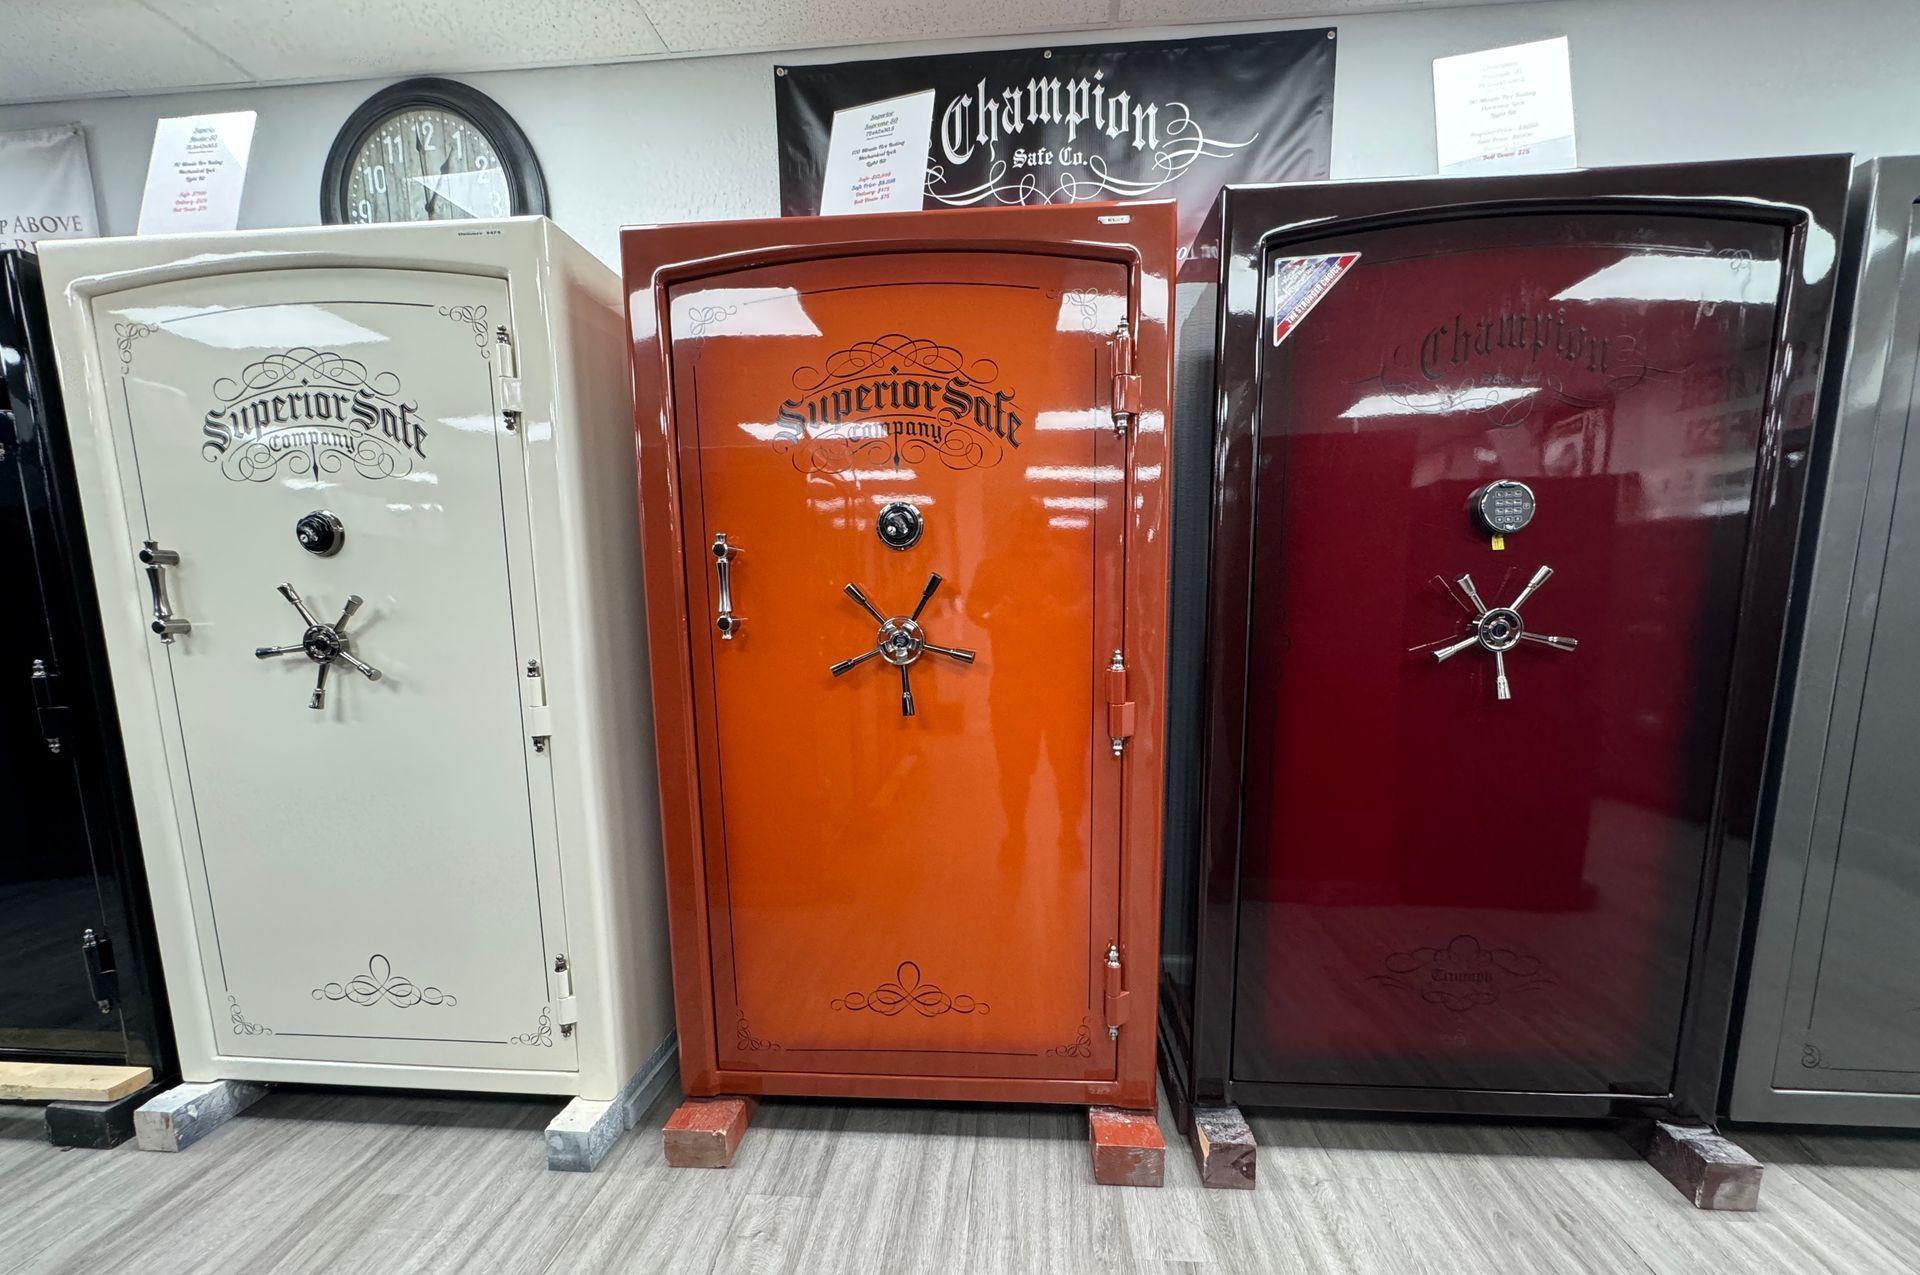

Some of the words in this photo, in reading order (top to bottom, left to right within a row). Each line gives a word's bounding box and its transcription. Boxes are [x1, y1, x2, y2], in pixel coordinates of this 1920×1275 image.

[941, 69, 1160, 165] Champion
[383, 135, 404, 164] 11
[452, 130, 463, 160] 1
[1012, 147, 1053, 169] Safe
[1058, 146, 1088, 166] Co.
[363, 165, 387, 195] 10
[475, 155, 490, 185] 2
[358, 199, 372, 224] 9
[488, 190, 503, 218] 3
[14, 215, 83, 233] ABOVE
[1286, 309, 1300, 324] THE
[1296, 284, 1323, 312] STRONGER
[1320, 263, 1342, 287] CHOICE
[1420, 308, 1610, 381] Champion
[202, 379, 350, 462] Superior
[349, 388, 428, 460] Safe
[773, 367, 942, 454] Superior
[938, 376, 1024, 449] Safe
